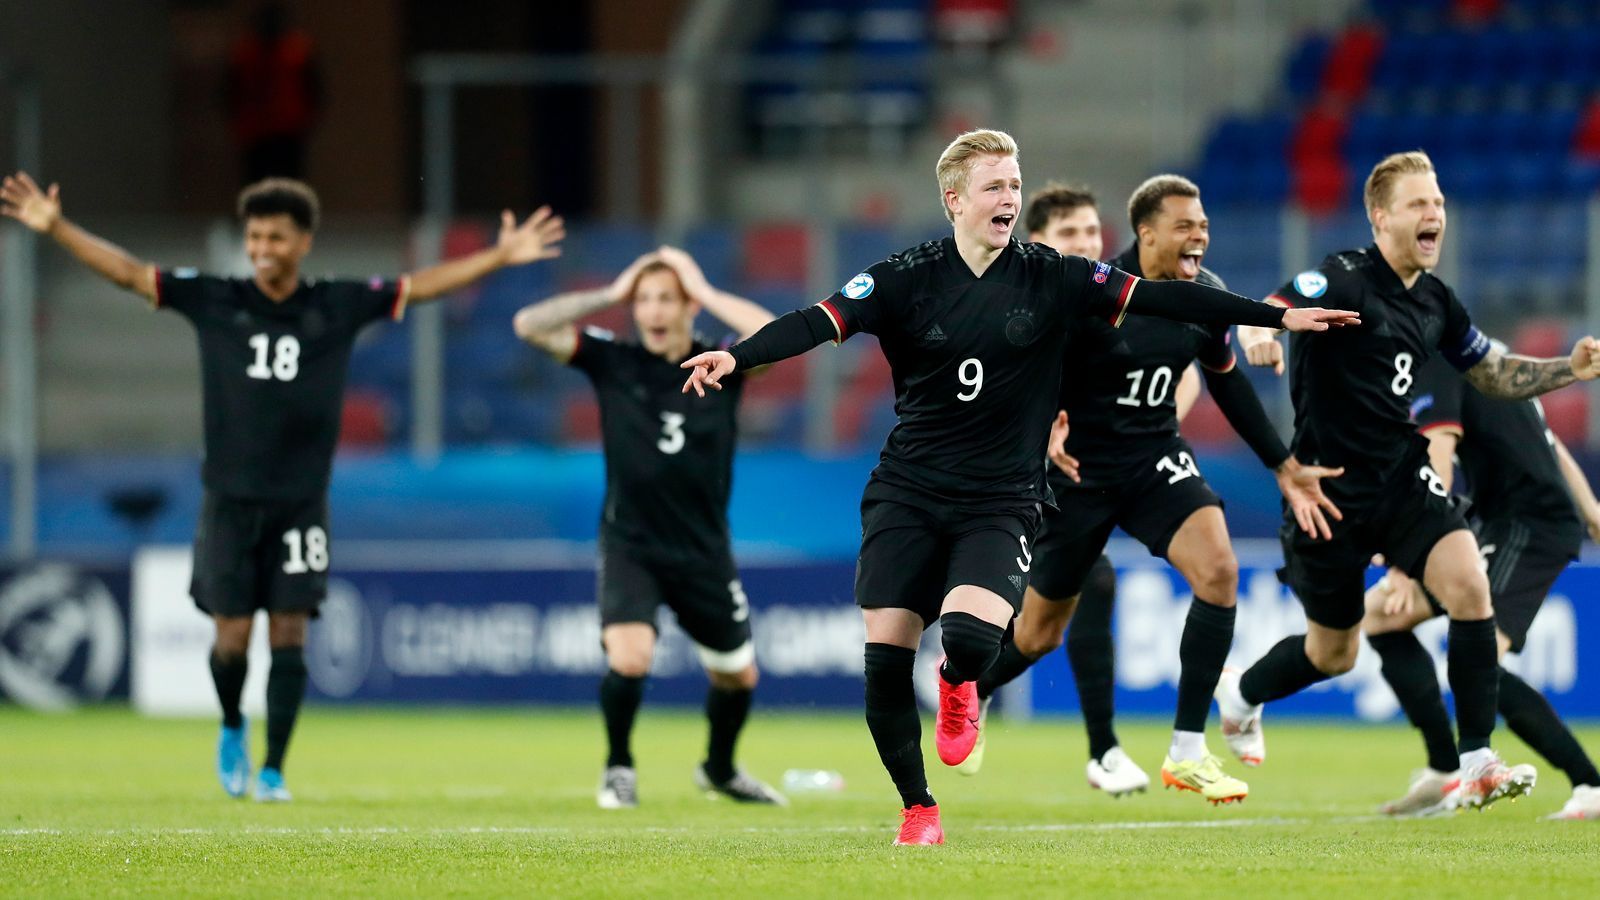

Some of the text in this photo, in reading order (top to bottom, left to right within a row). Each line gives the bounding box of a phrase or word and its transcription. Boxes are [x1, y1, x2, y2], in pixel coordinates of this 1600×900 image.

[247, 332, 301, 381] 18
[1391, 352, 1413, 396] 8
[957, 358, 983, 401] 9
[1116, 365, 1172, 407] 10
[658, 410, 686, 455] 3
[282, 525, 329, 574] 18
